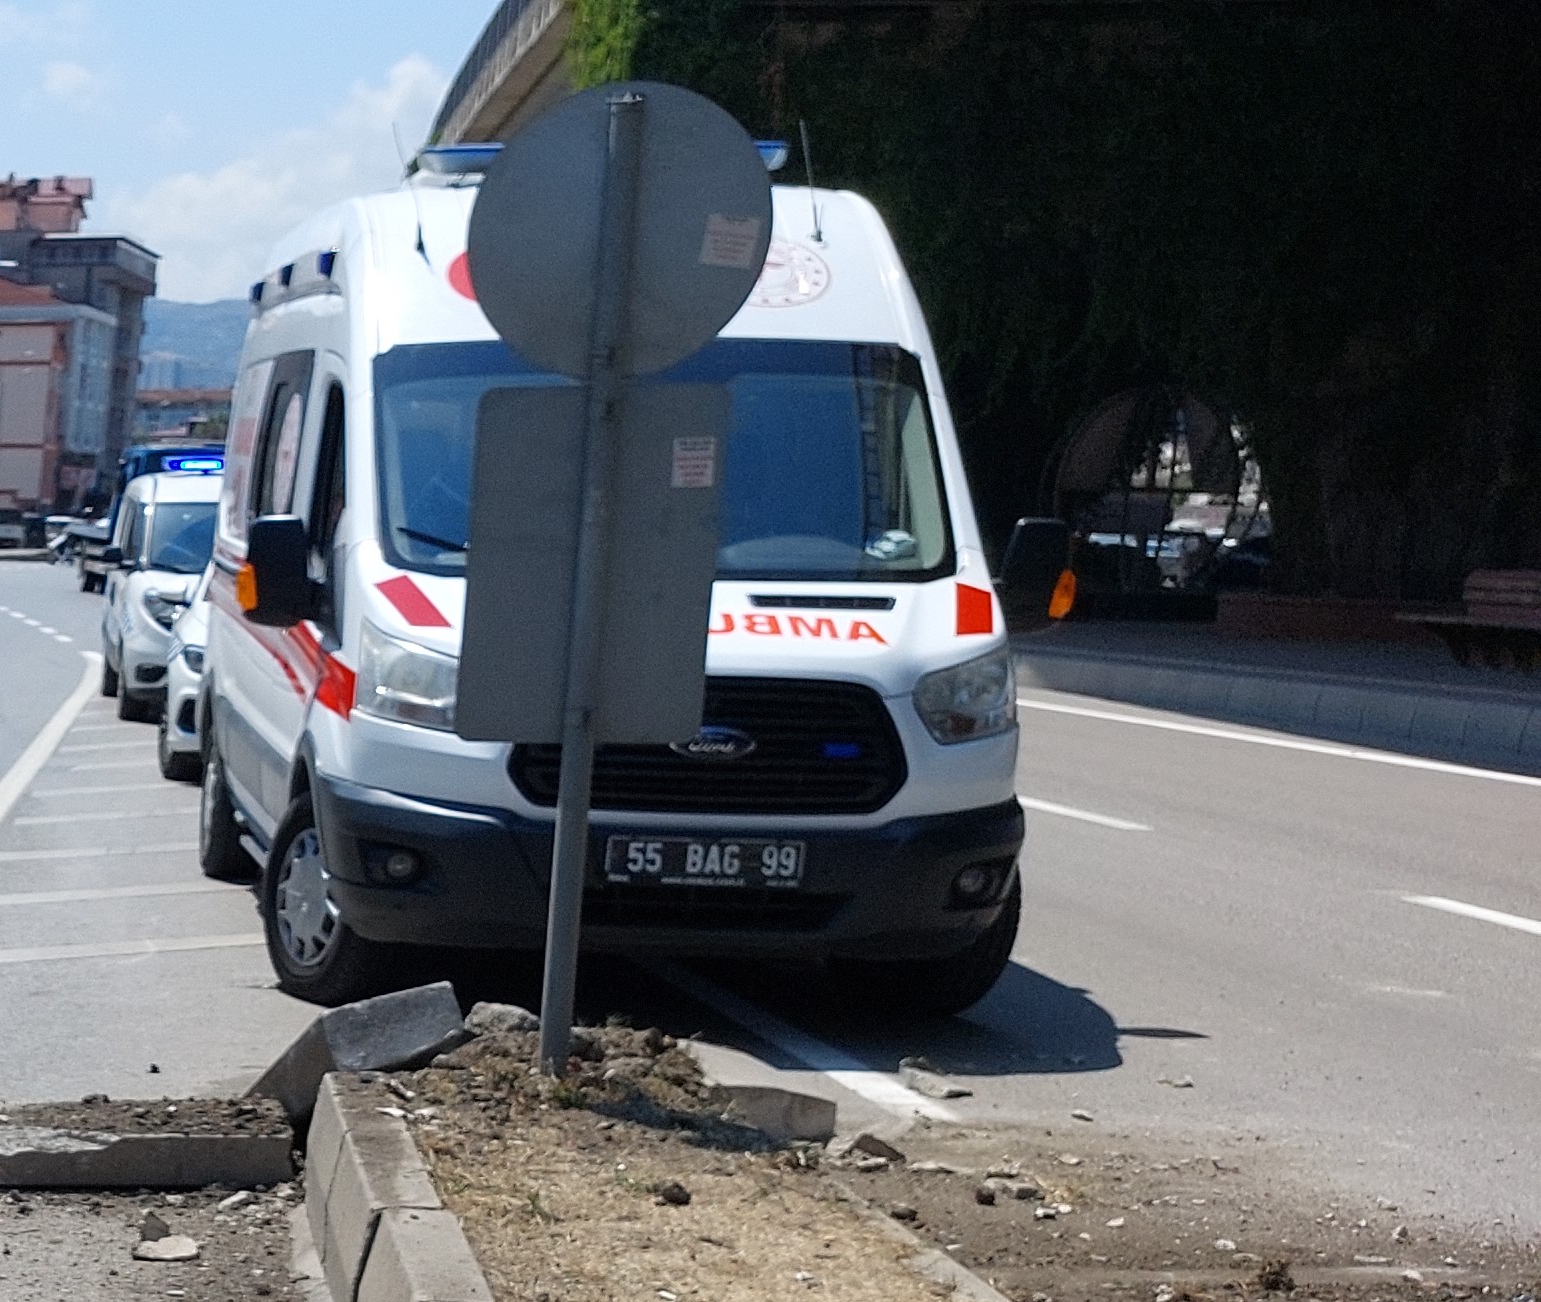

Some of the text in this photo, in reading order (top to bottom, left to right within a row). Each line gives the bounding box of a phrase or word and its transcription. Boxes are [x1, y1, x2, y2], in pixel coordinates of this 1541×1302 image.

[626, 842, 797, 877] 55 BAG 99
